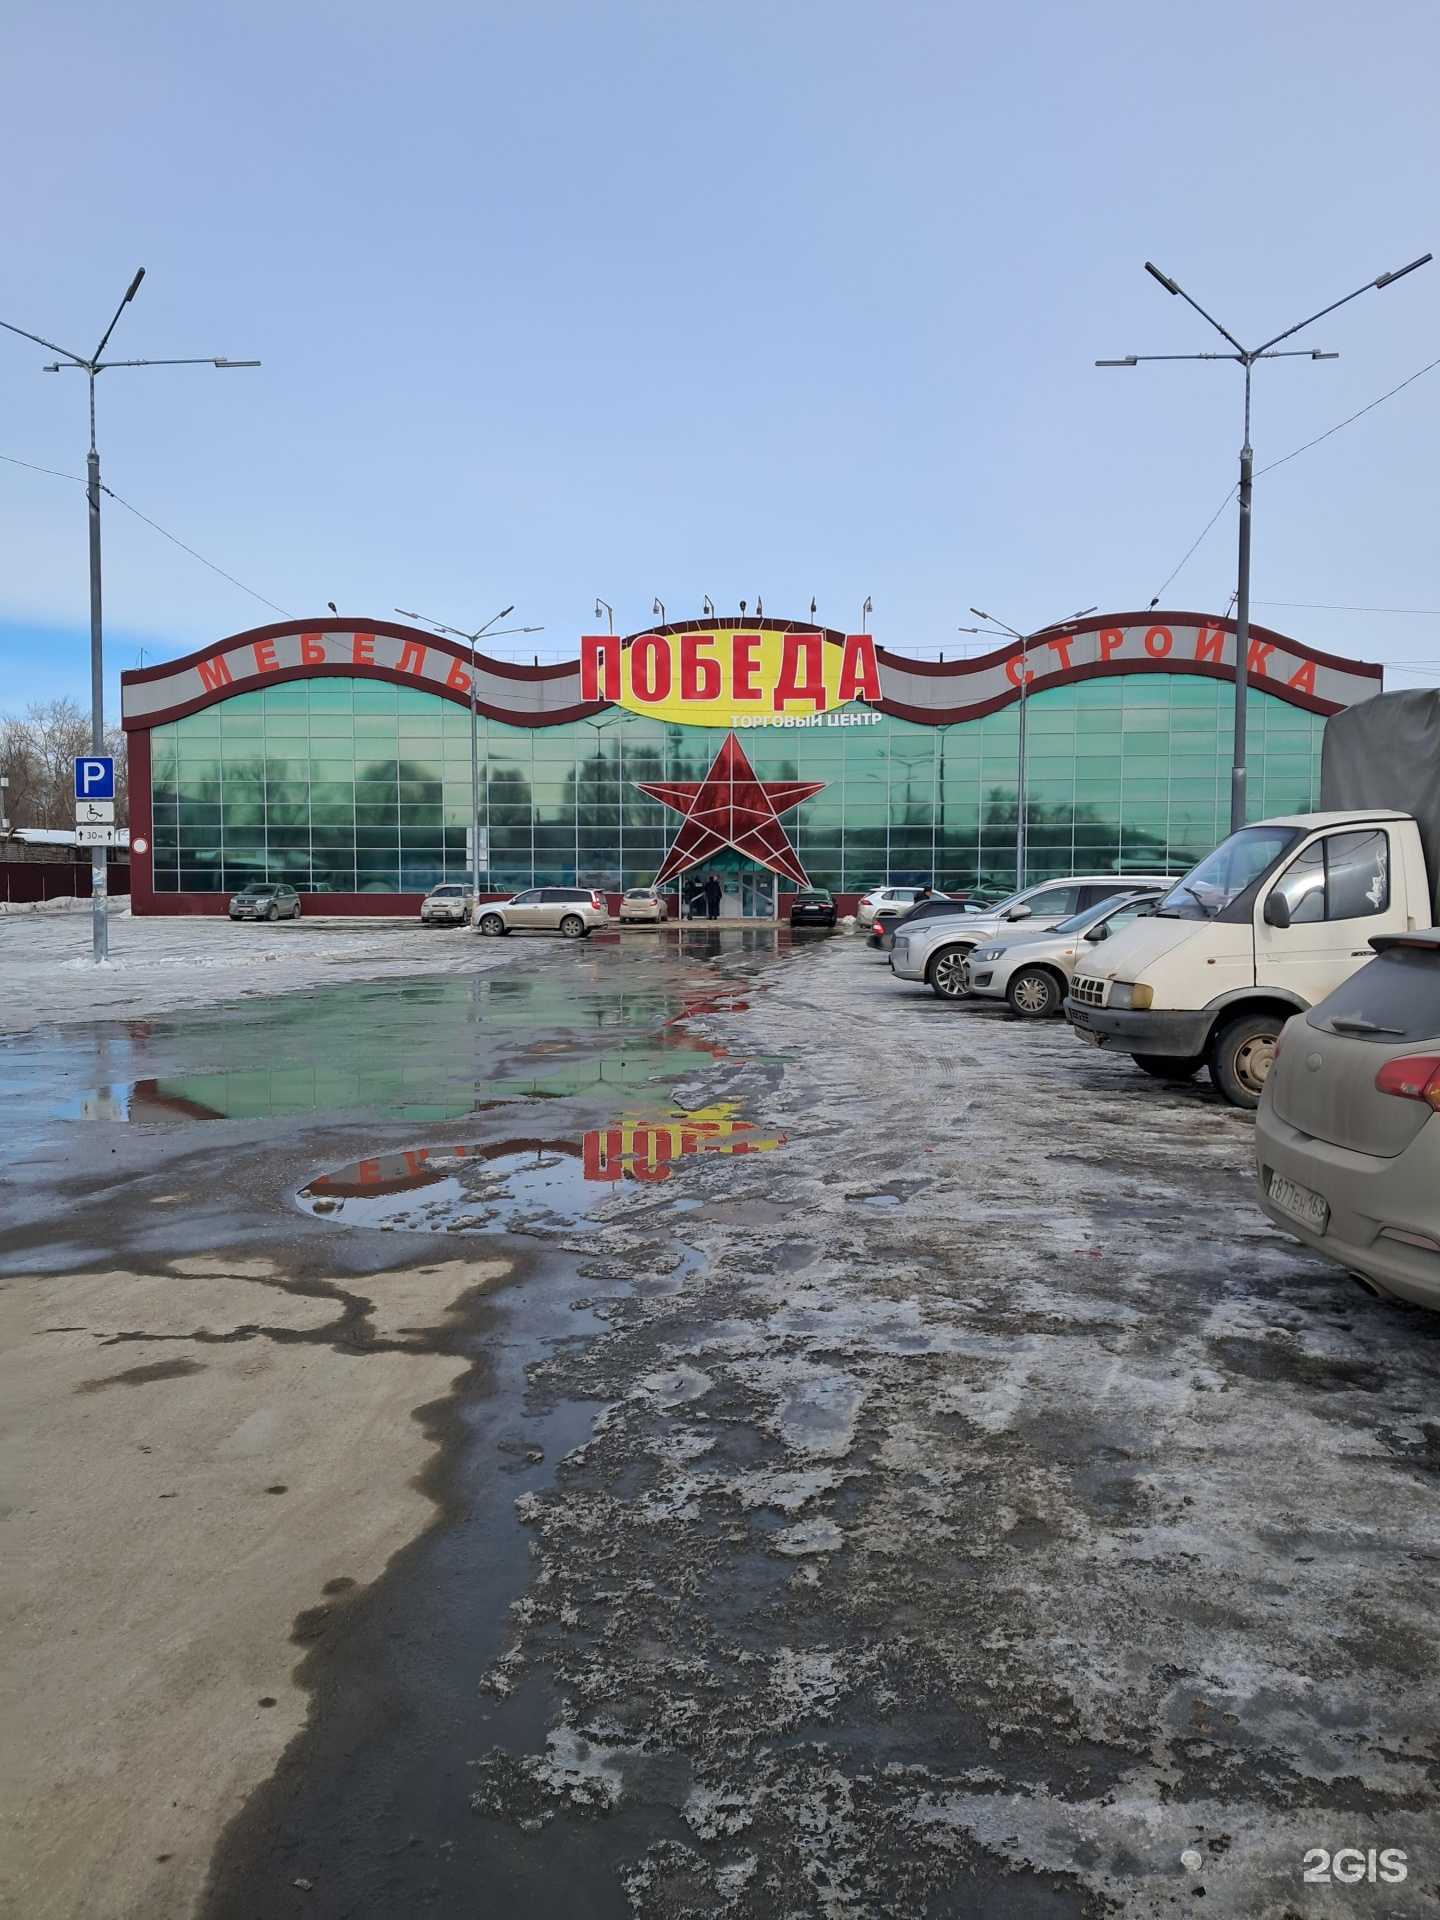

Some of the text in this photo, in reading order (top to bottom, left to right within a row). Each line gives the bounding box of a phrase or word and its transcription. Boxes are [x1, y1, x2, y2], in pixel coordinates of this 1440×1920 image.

[196, 632, 472, 693] МЕБЕЛЬ
[580, 634, 882, 712] ПОБЕДА
[1005, 622, 1317, 695] СТРОЙКА
[730, 711, 882, 728] ТОРГОВЫЙ ЦЕНТР
[83, 762, 105, 793] P
